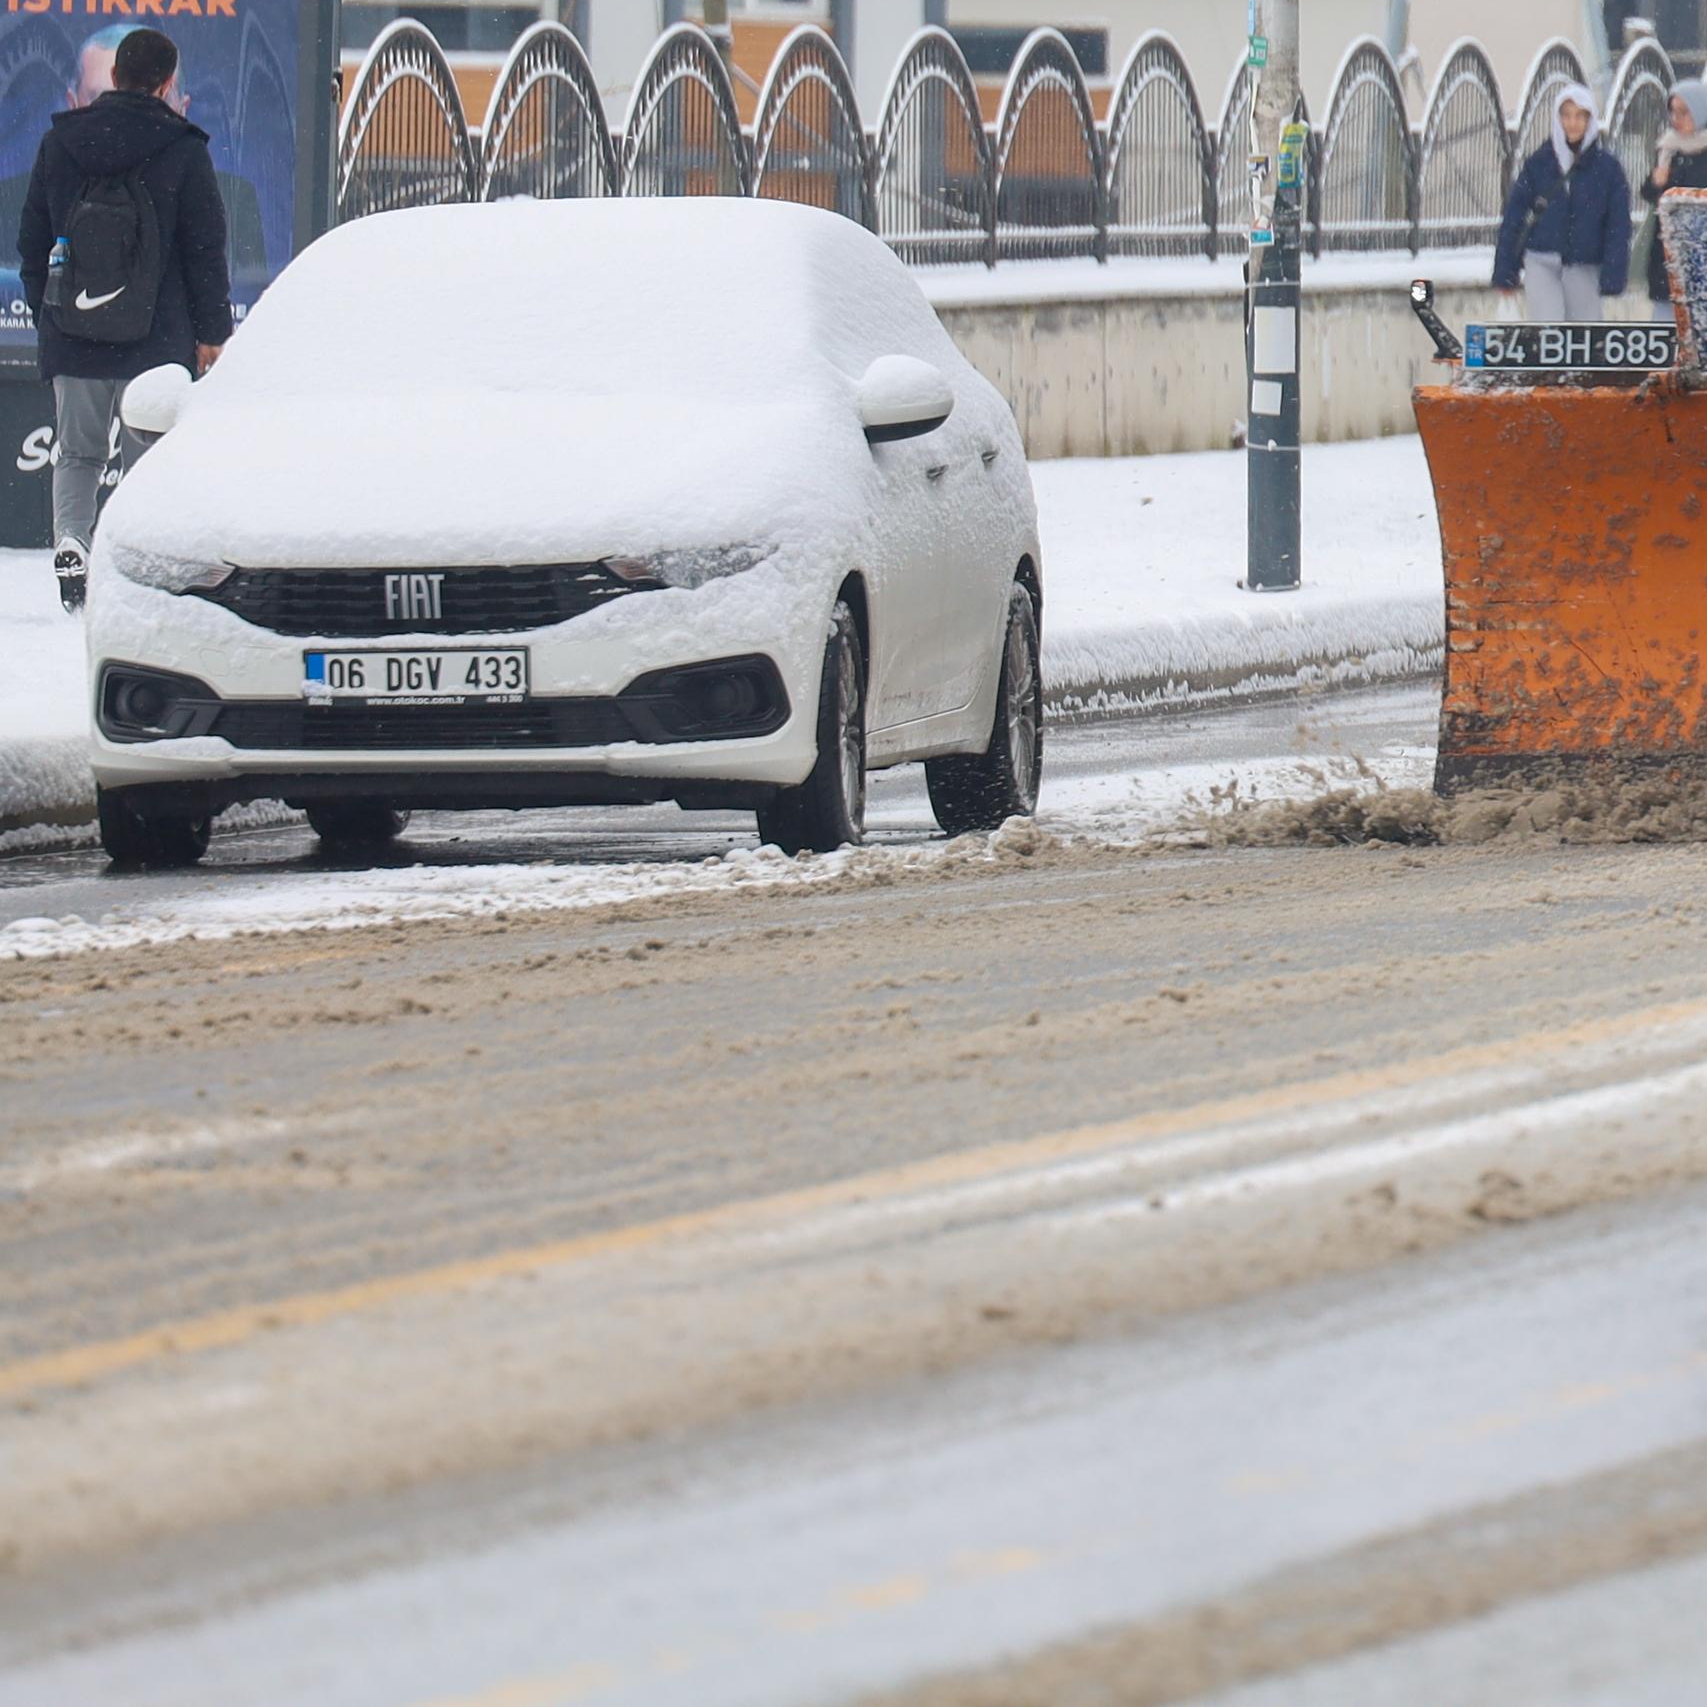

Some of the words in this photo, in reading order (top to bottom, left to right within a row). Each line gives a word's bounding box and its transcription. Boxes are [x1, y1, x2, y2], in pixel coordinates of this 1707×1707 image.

[1485, 329, 1525, 363] 54
[1540, 330, 1591, 364] BH
[1605, 330, 1670, 364] 685
[385, 574, 445, 619] FIAT
[329, 658, 365, 689] 06
[387, 657, 443, 691] DGV
[465, 656, 522, 689] 433
